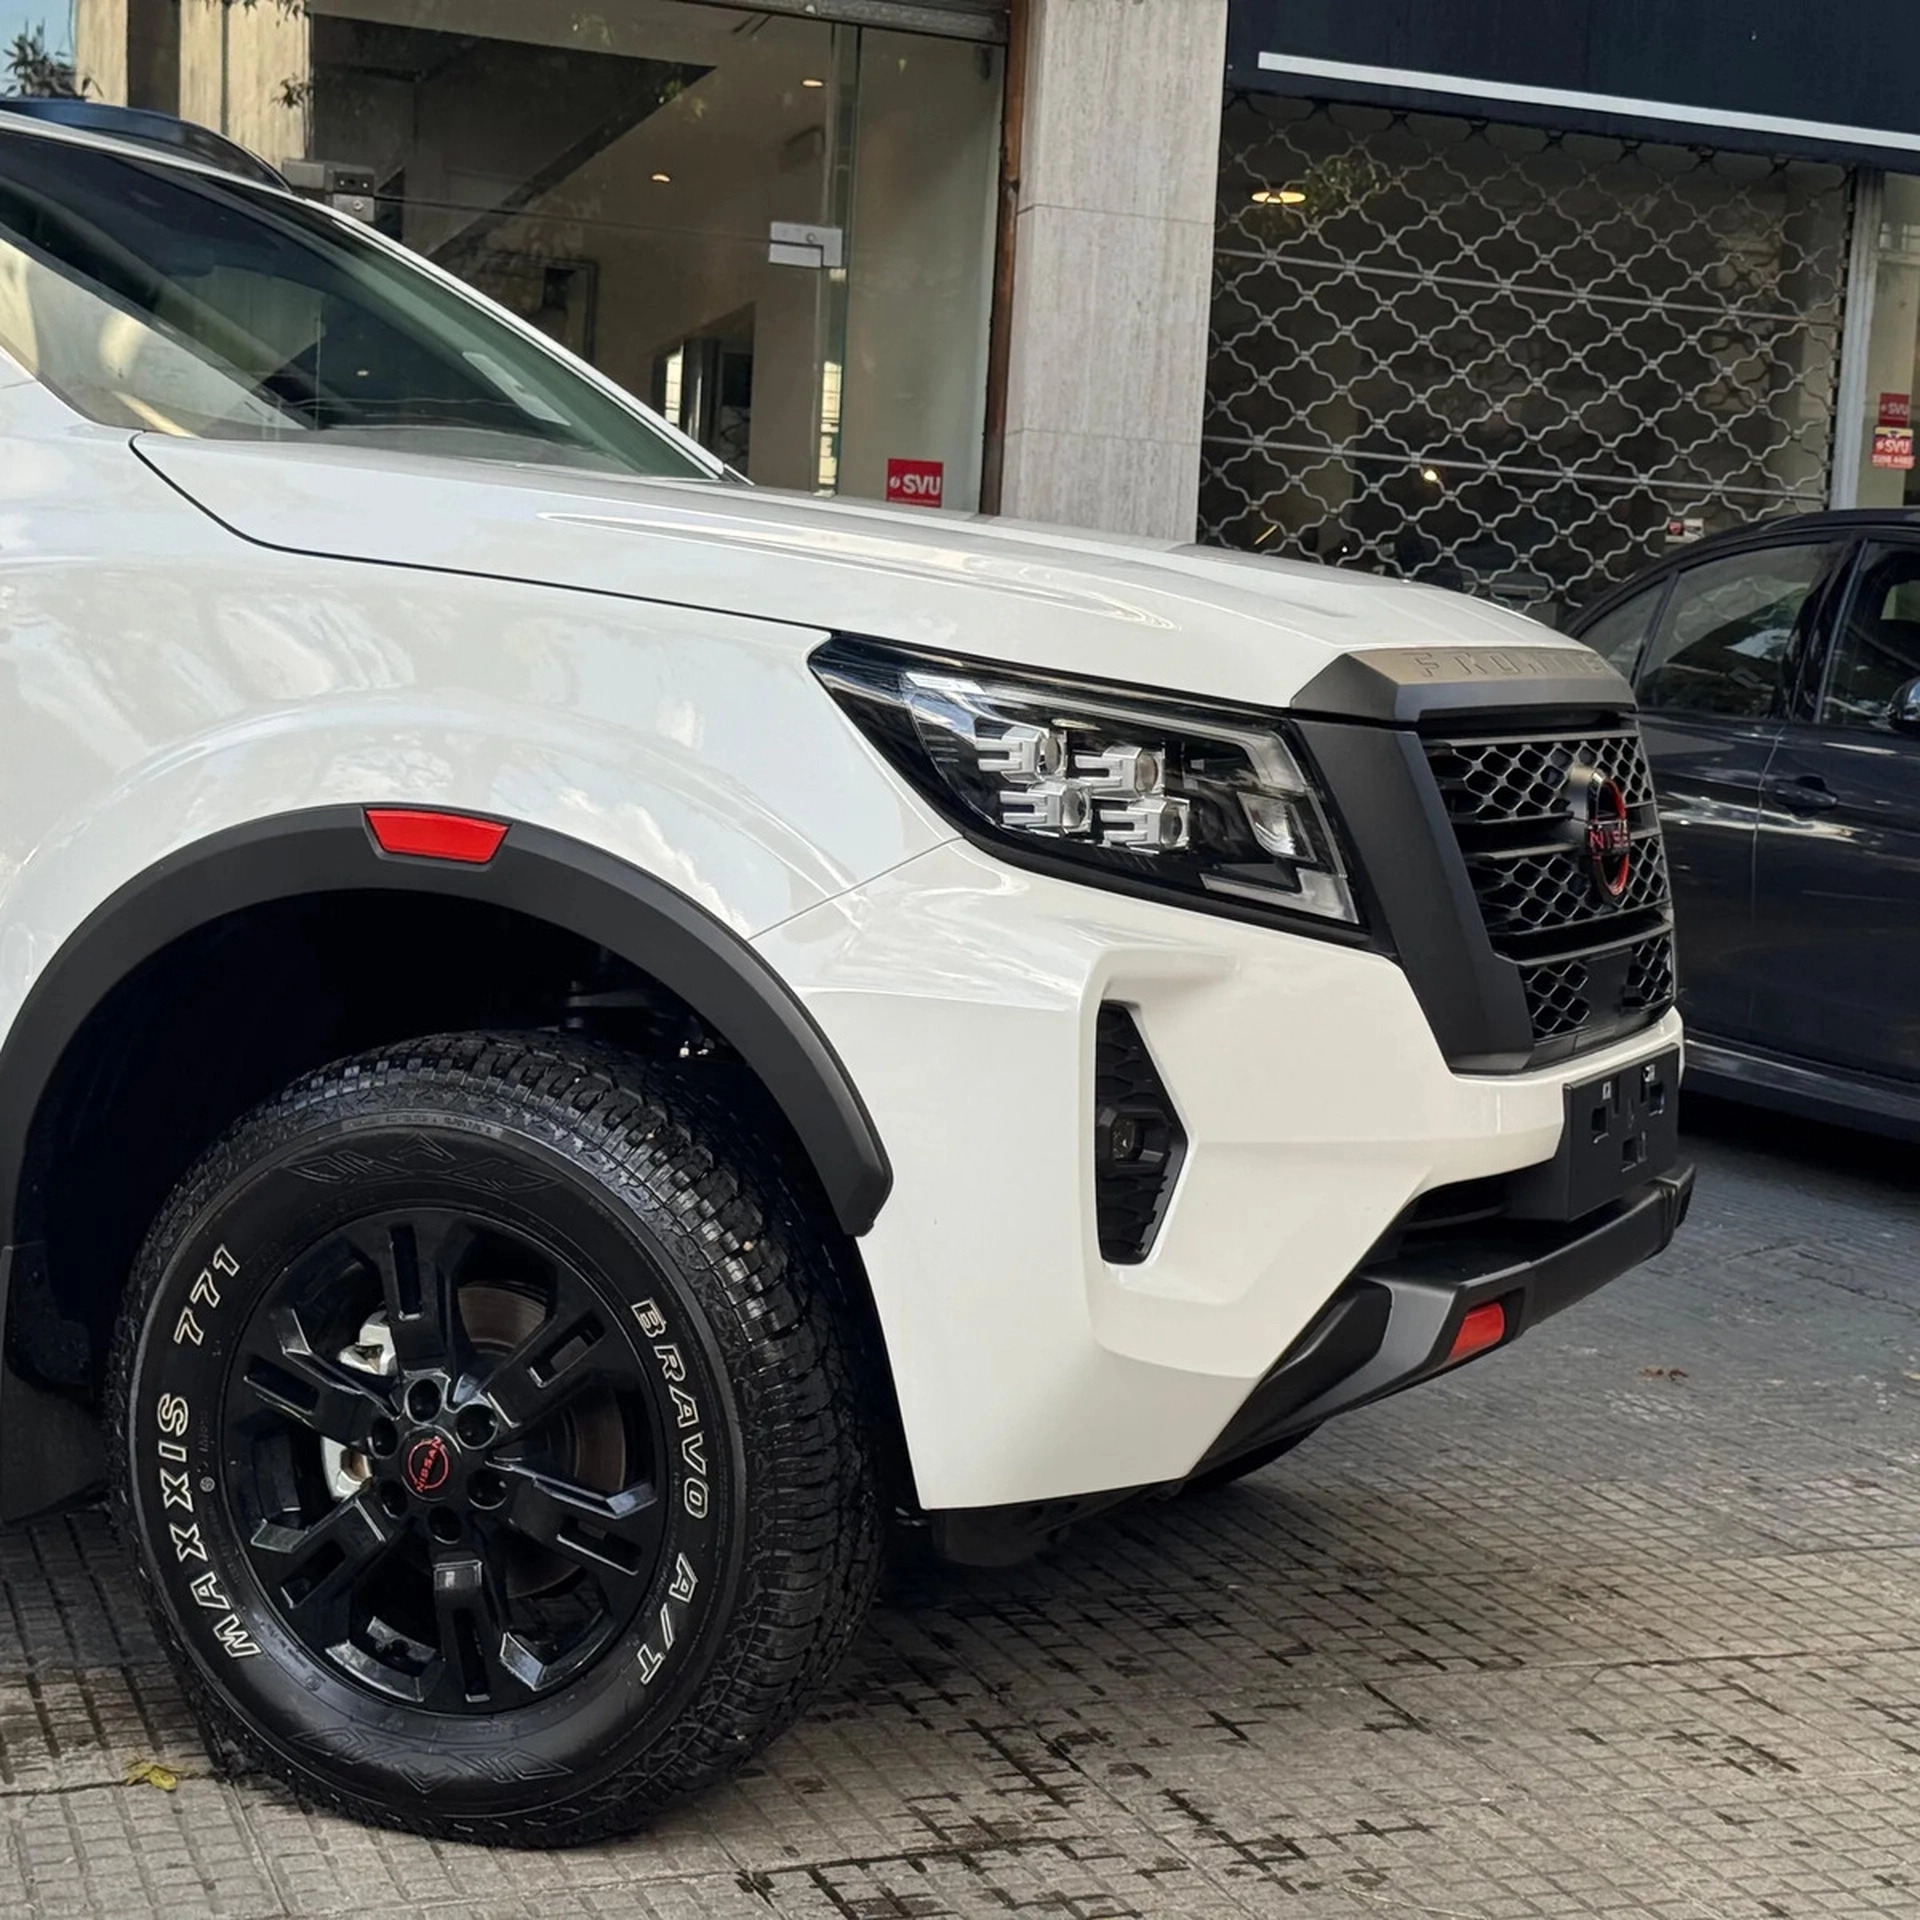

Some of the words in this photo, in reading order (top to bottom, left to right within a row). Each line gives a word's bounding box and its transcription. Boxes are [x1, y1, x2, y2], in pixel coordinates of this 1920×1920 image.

[1888, 402, 1908, 416] SVU
[1884, 439, 1910, 455] SVU
[902, 473, 941, 496] SVU
[1400, 650, 1606, 678] FRONTIE
[173, 1243, 241, 1348] 771
[630, 1298, 710, 1521] BRAVO
[414, 1435, 443, 1493] NISSAN
[157, 1393, 264, 1660] MAXXIS
[636, 1551, 700, 1687] A/T
